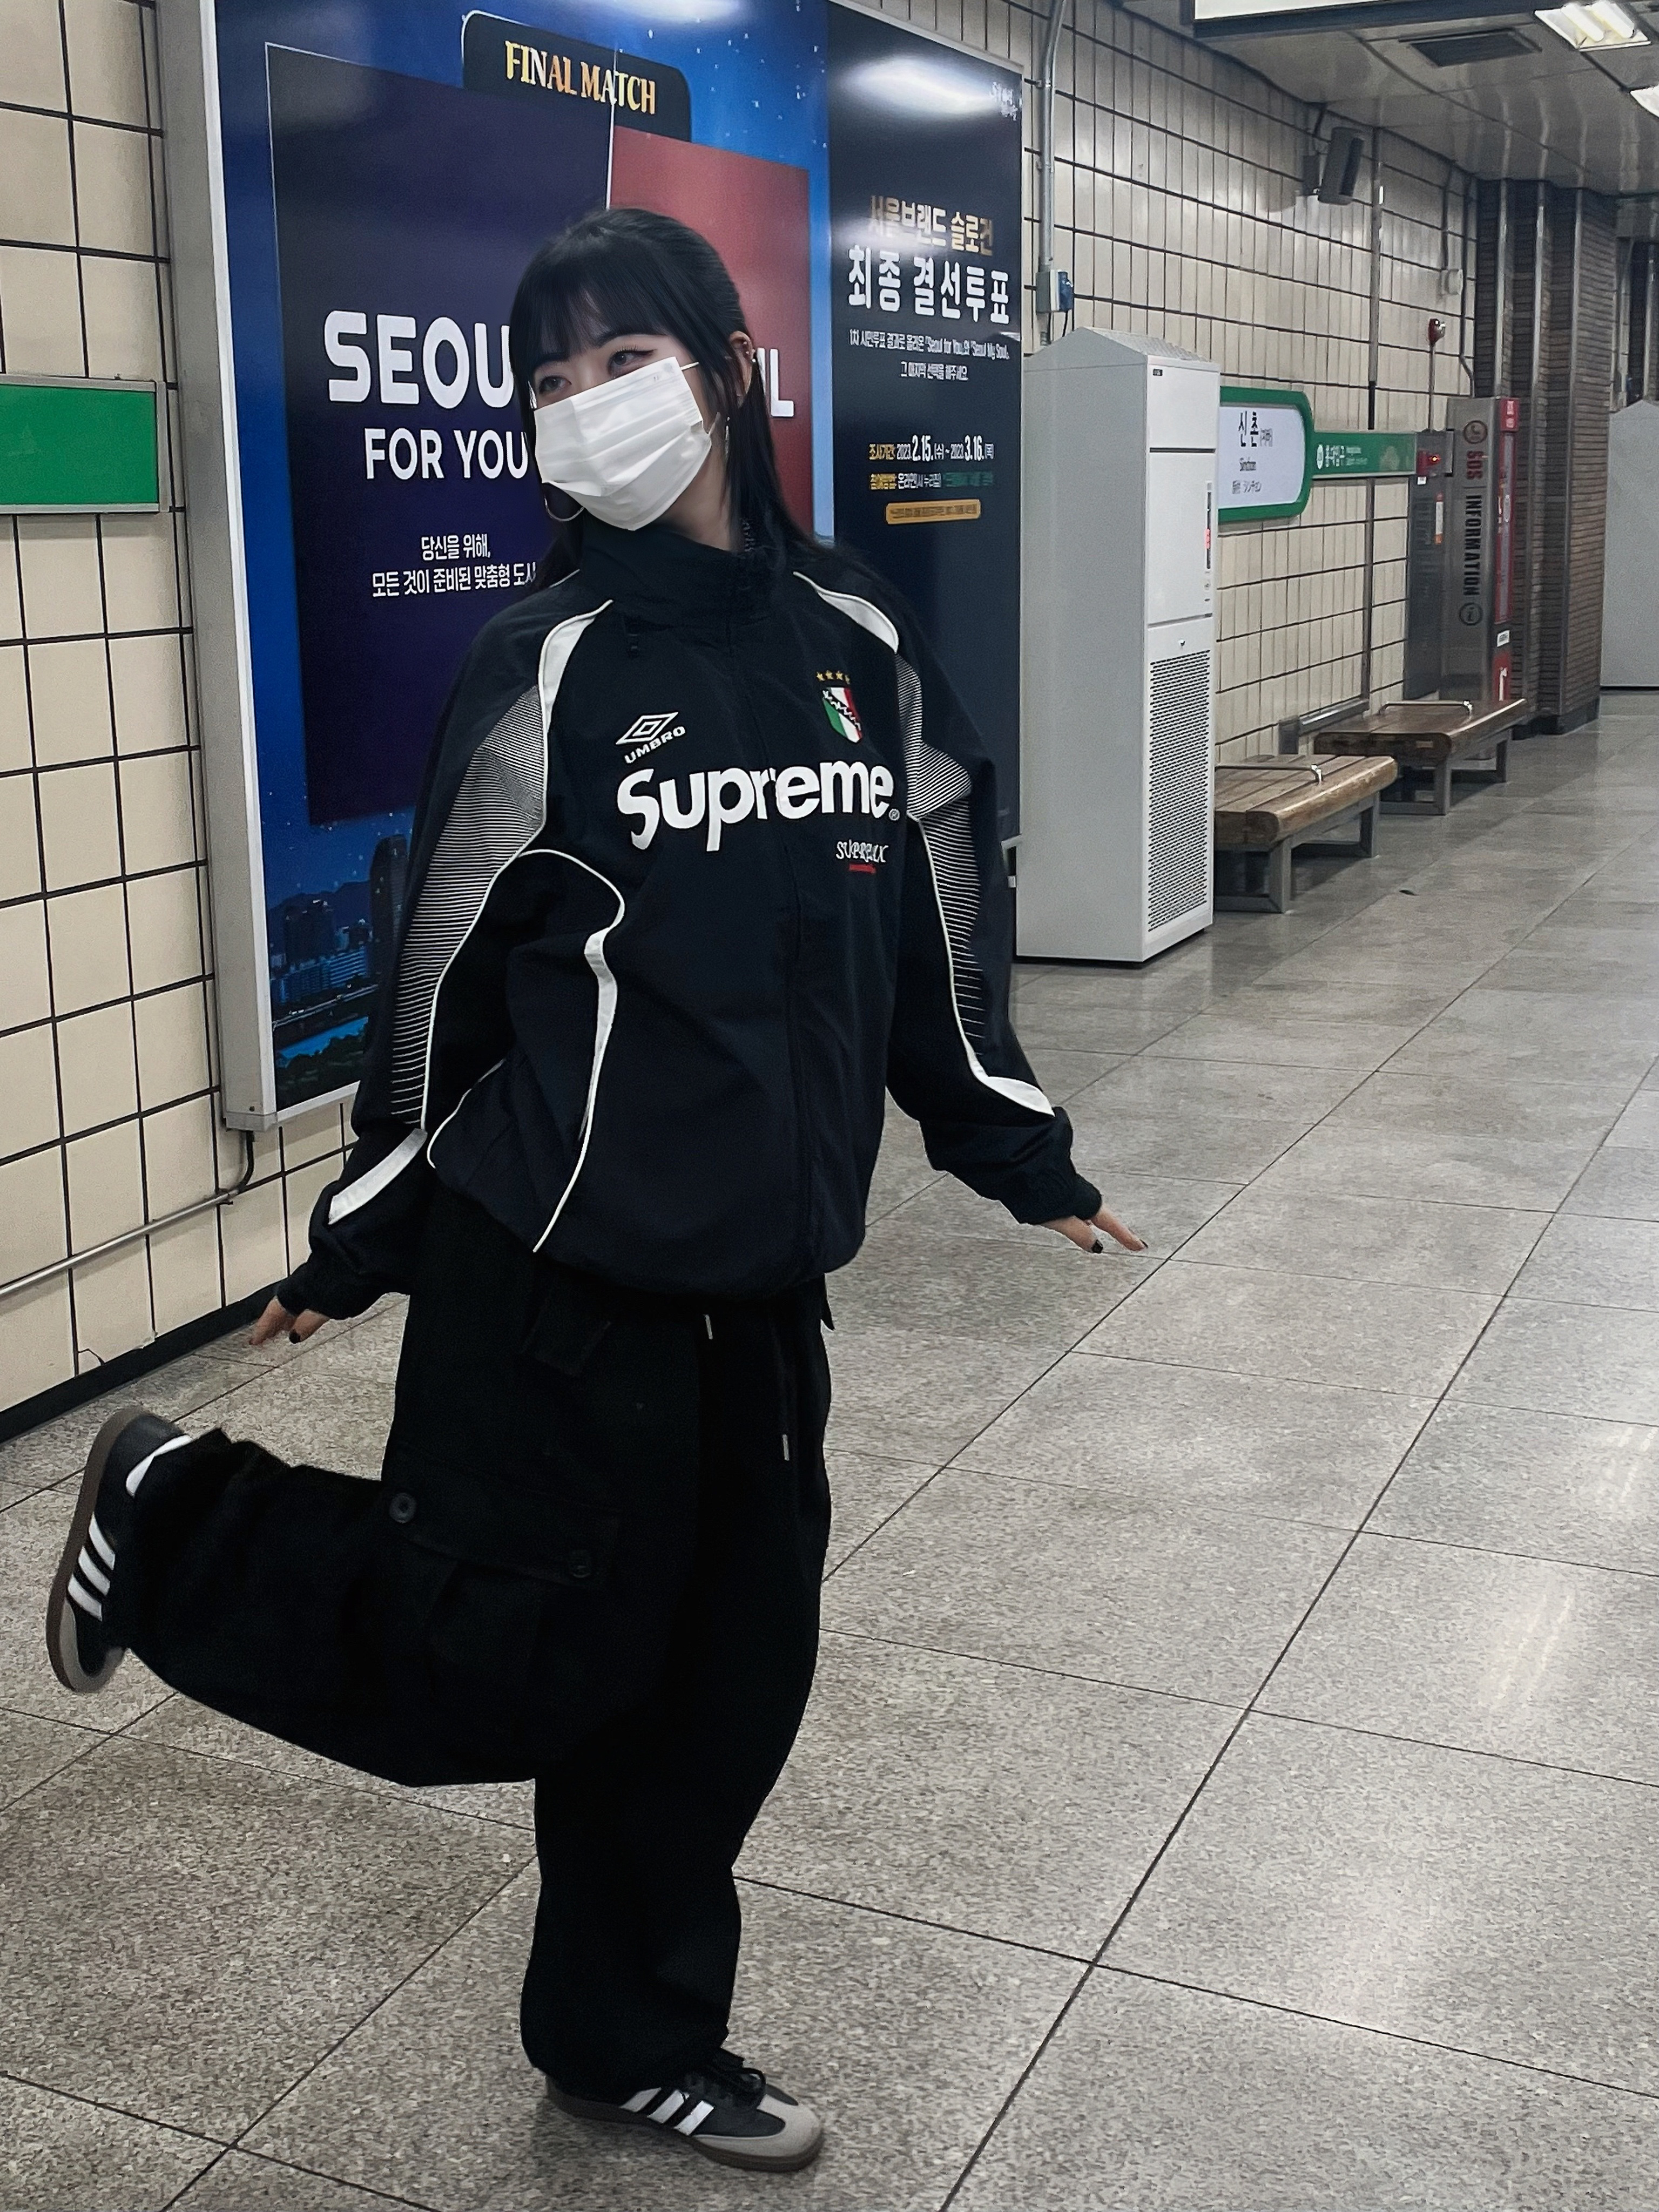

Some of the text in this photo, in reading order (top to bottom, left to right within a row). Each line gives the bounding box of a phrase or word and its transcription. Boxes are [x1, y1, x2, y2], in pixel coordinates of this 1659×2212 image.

[505, 41, 656, 114] FINAL MATCH
[950, 211, 993, 256] 슬로건
[848, 245, 1009, 324] 최종 결선투표
[324, 310, 515, 409] SEOU
[365, 428, 529, 480] FOR YOU
[1238, 410, 1259, 447] 신촌
[421, 533, 491, 561] 당신을 위해,
[1464, 495, 1482, 596] INFORMATION
[373, 571, 400, 597] 모든
[403, 569, 430, 595] 것이
[433, 565, 471, 594] 준비된
[474, 563, 510, 590] 맞춤형
[624, 726, 686, 764] UMBRO
[617, 760, 894, 852] Supreme
